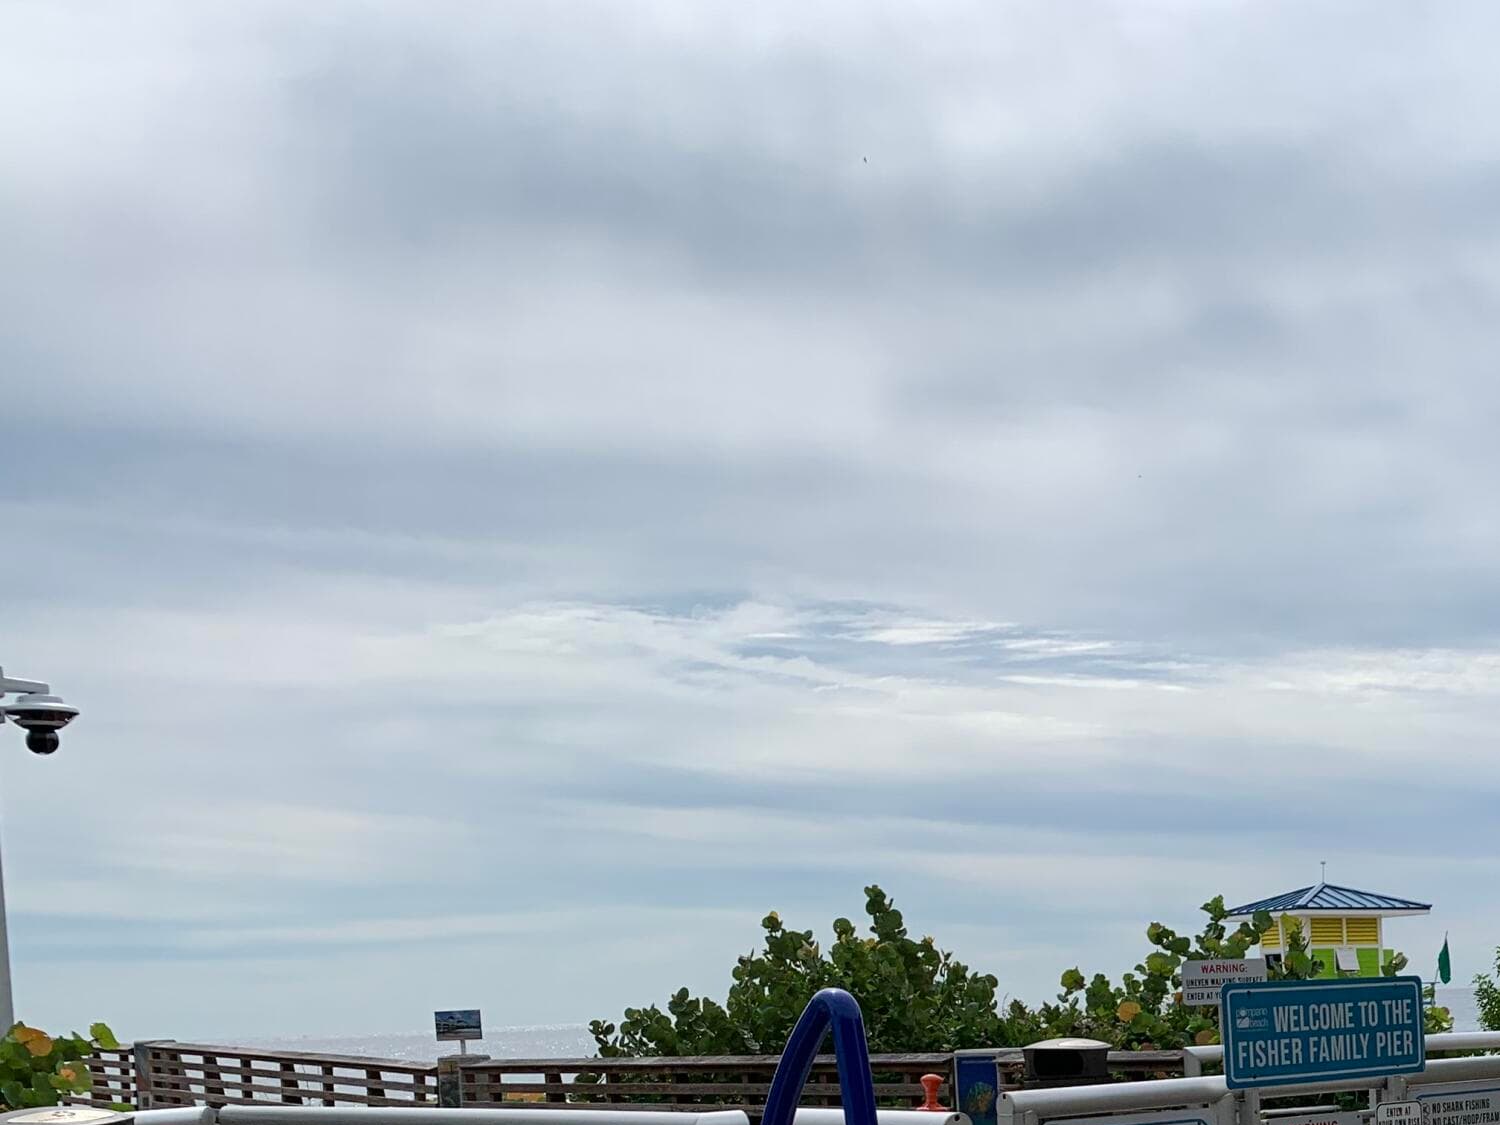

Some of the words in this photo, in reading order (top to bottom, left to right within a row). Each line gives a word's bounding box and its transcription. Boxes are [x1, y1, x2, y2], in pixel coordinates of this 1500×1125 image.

[1201, 963, 1248, 974] WARNING:
[1186, 978, 1209, 987] UNEVEN
[1187, 992, 1205, 1000] ENTER
[1207, 991, 1214, 1000] AT
[1273, 1003, 1354, 1033] WELCOME
[1358, 1001, 1379, 1028] TO
[1382, 999, 1413, 1025] THE
[1238, 1038, 1303, 1069] FISHER
[1309, 1032, 1370, 1063] FAMILY
[1376, 1030, 1414, 1057] PIER
[1386, 1107, 1403, 1117] ENTER
[1404, 1106, 1411, 1115] AT
[1432, 1103, 1441, 1114] NO
[1442, 1100, 1464, 1113] SHARK
[1465, 1098, 1490, 1110] FISHING
